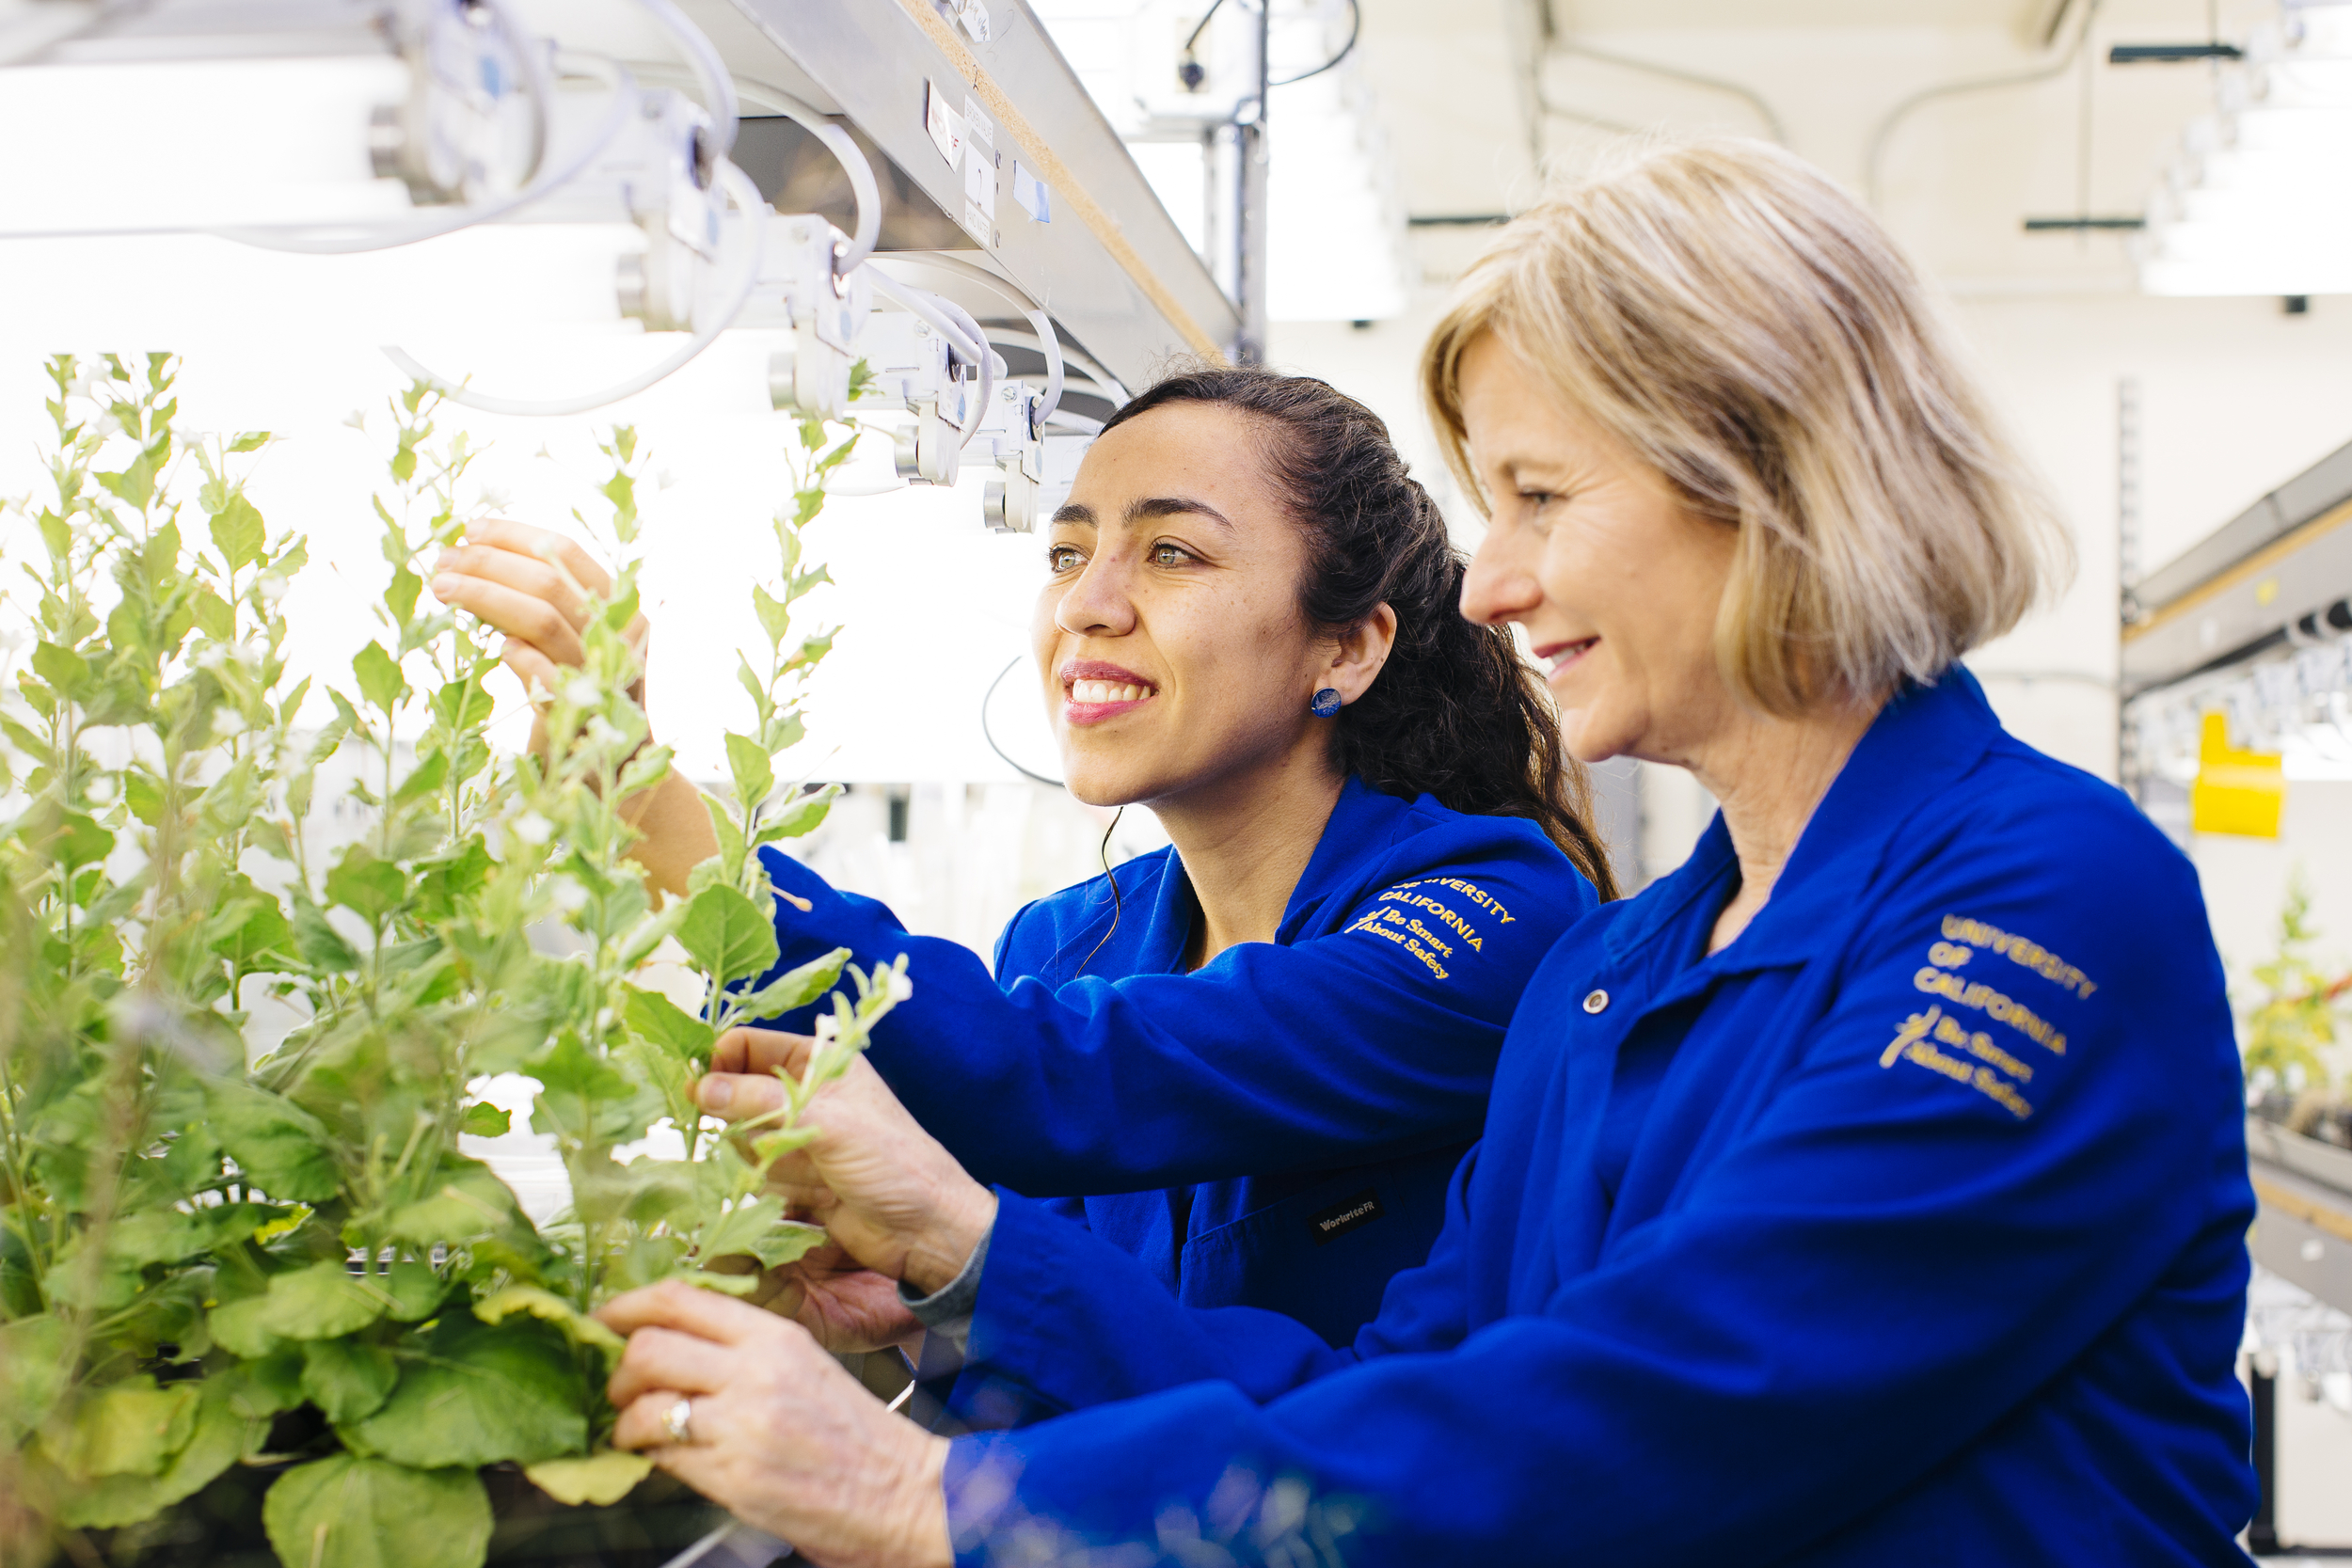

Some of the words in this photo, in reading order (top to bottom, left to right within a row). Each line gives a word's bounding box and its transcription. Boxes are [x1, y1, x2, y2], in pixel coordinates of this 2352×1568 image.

[1377, 890, 1484, 953] CALIFORNIA
[1423, 877, 1517, 925] VERSITY
[1358, 920, 1406, 944] About
[1403, 938, 1450, 980] Safety
[1382, 909, 1406, 926] Be
[1405, 918, 1454, 958] Smart
[1928, 941, 1974, 970] OF
[1940, 913, 2097, 1000] UNIVERSITY
[1913, 966, 2067, 1056] CALIFORNIA
[1933, 1015, 1968, 1049] Be
[1969, 1031, 2034, 1084] Smart
